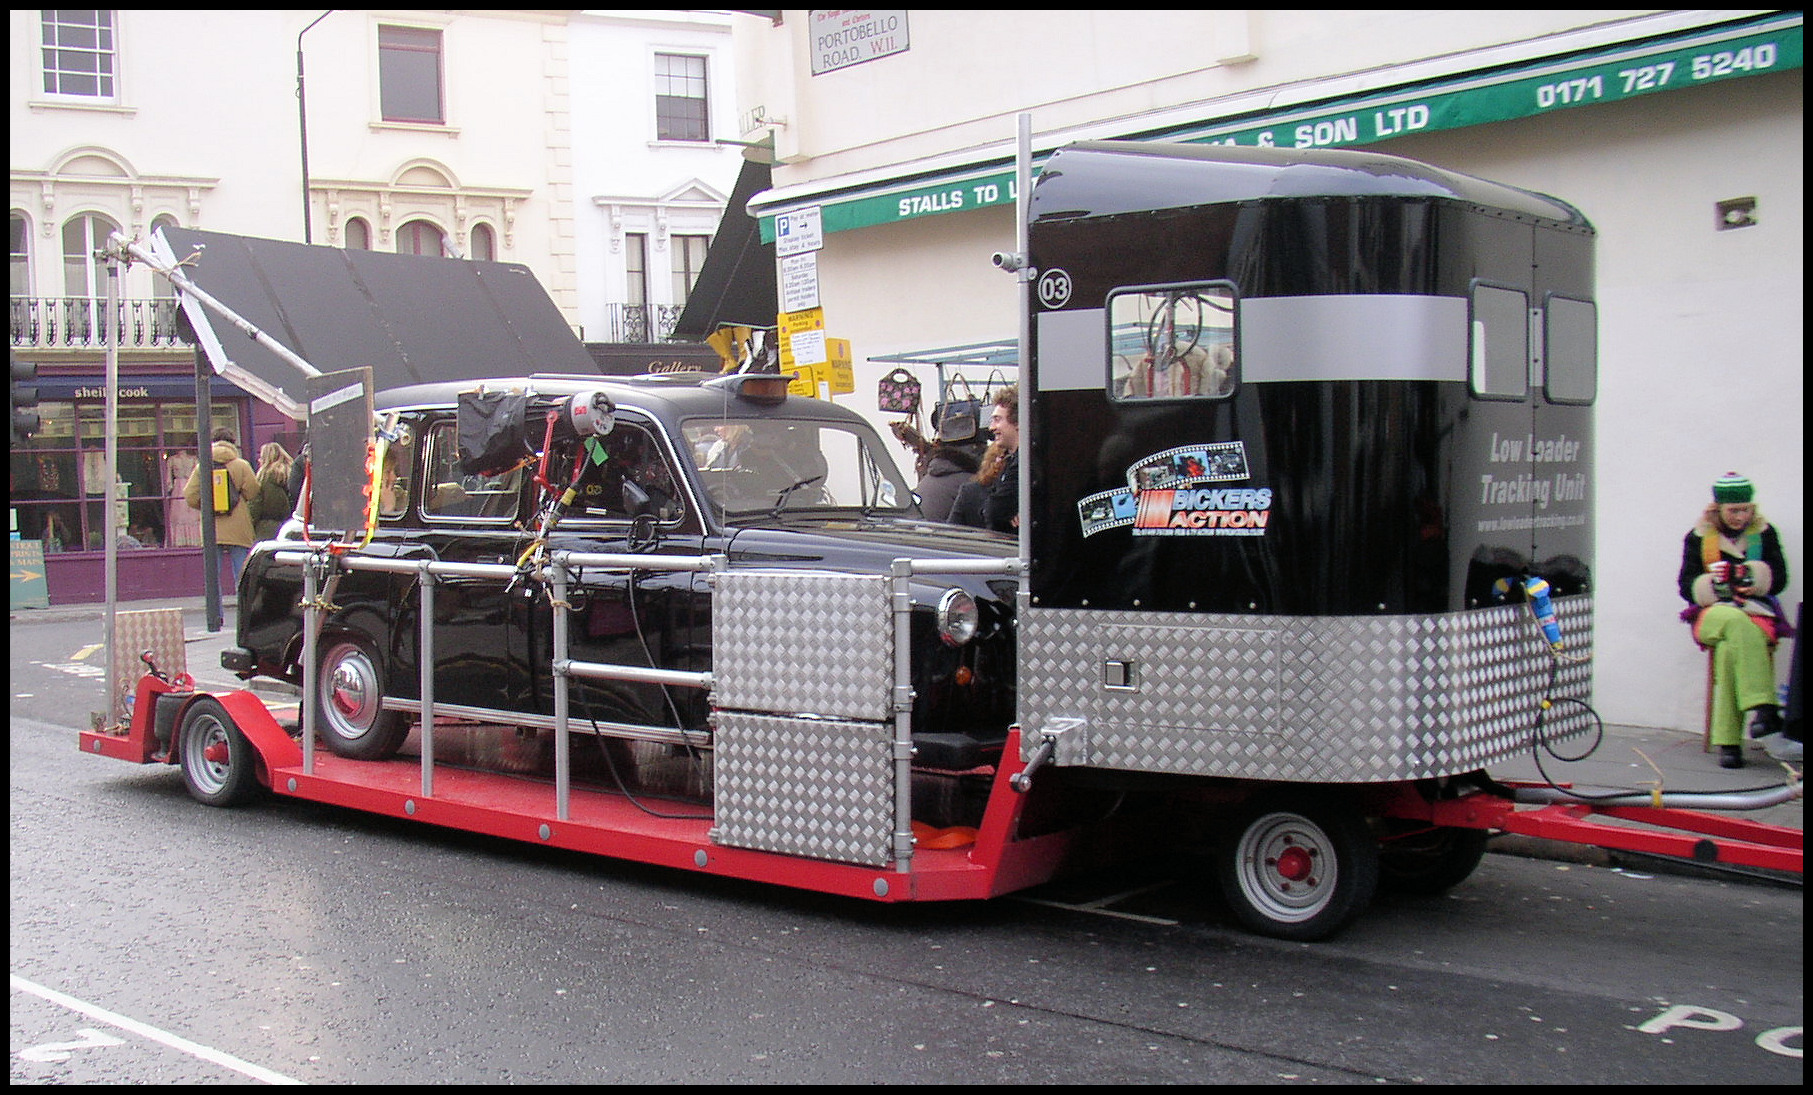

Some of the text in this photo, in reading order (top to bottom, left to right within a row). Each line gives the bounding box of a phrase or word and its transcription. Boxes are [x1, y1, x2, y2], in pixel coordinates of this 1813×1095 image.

[818, 15, 898, 51] PORTOBELLO
[1537, 43, 1778, 108] 0171 727 5240
[1294, 117, 1358, 149] SON
[1375, 104, 1430, 137] LTD
[898, 190, 964, 216] STALLS
[973, 184, 999, 204] TO
[1042, 277, 1068, 300] 03
[75, 386, 149, 398] sheil cook
[1490, 432, 1580, 463] Low Loader
[1172, 487, 1273, 511] BICKERS
[1482, 473, 1586, 510] Tracking Unit
[1168, 511, 1272, 529] ACTION
